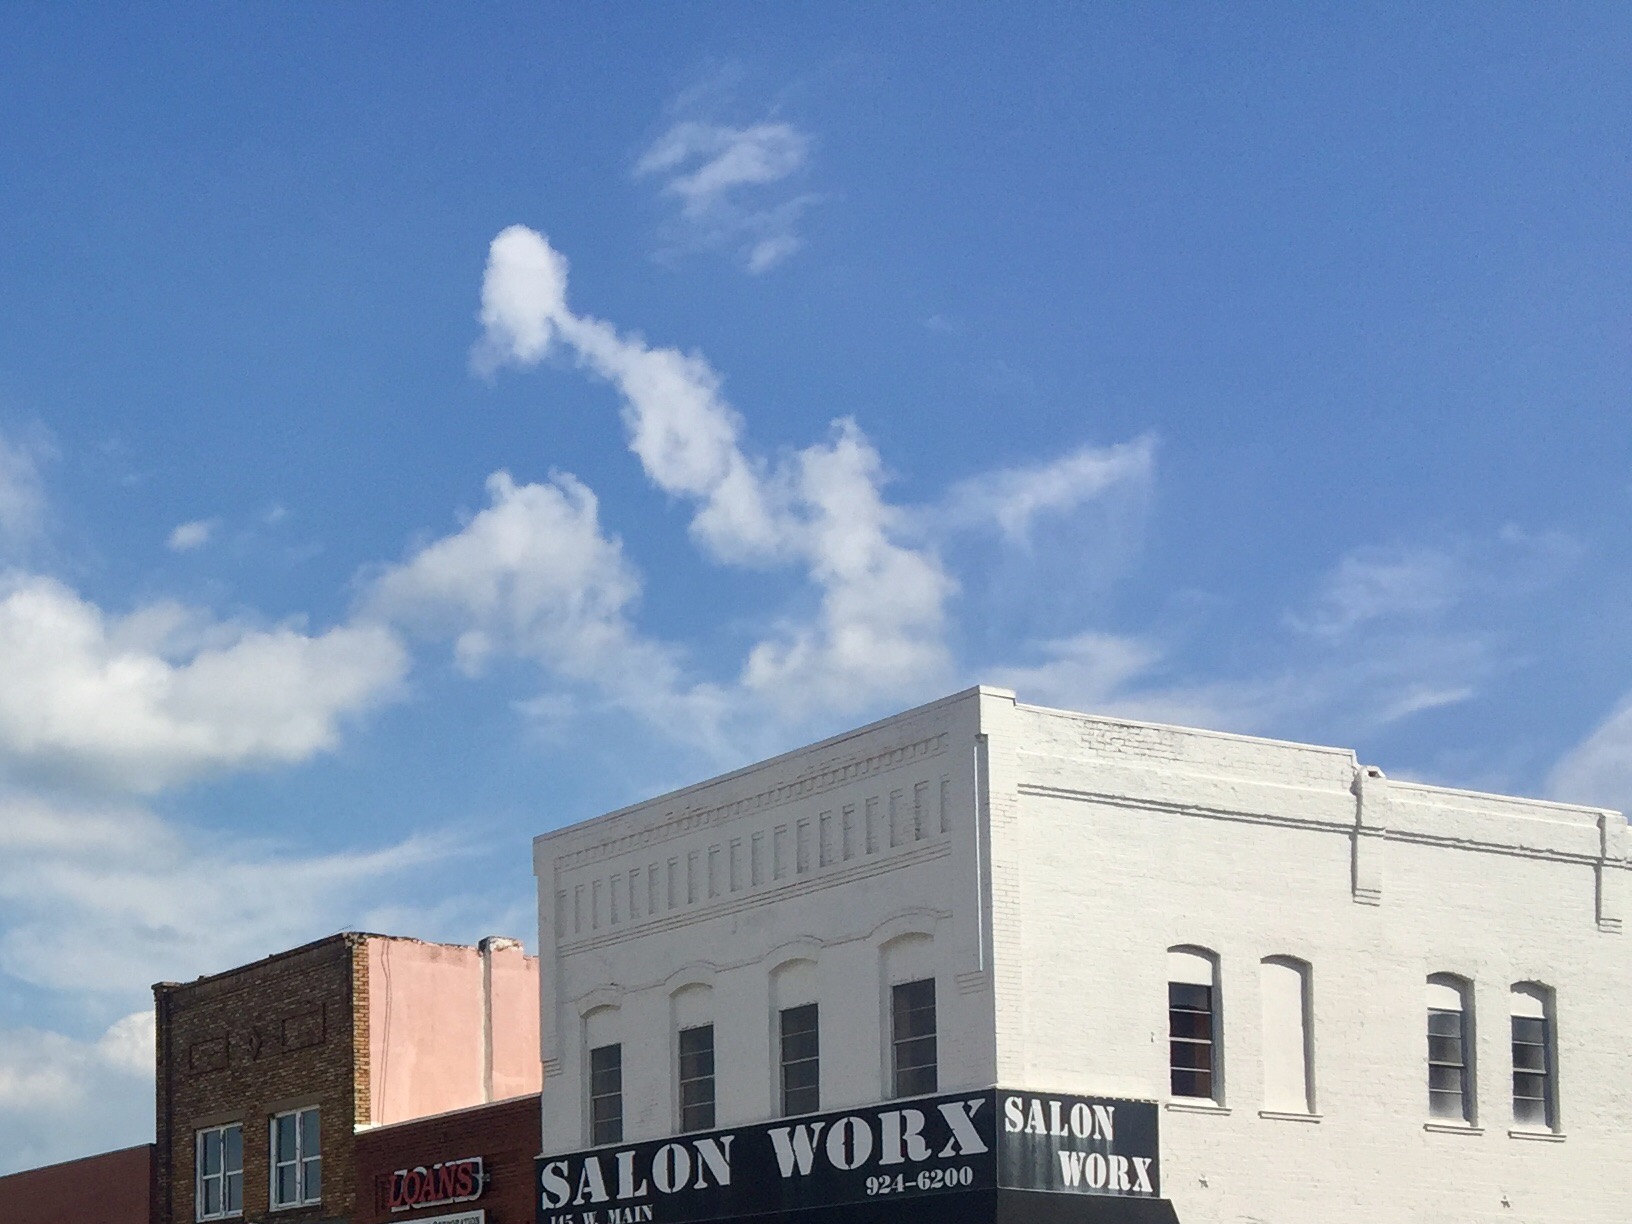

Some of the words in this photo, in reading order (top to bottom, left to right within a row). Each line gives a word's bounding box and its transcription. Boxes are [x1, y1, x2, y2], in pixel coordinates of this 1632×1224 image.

[1005, 1096, 1115, 1141] SALON
[541, 1135, 735, 1211] SALON
[767, 1098, 989, 1179] WORX
[1058, 1151, 1153, 1193] WORX
[389, 1159, 480, 1210] LOANS
[866, 1166, 974, 1196] 924-6200
